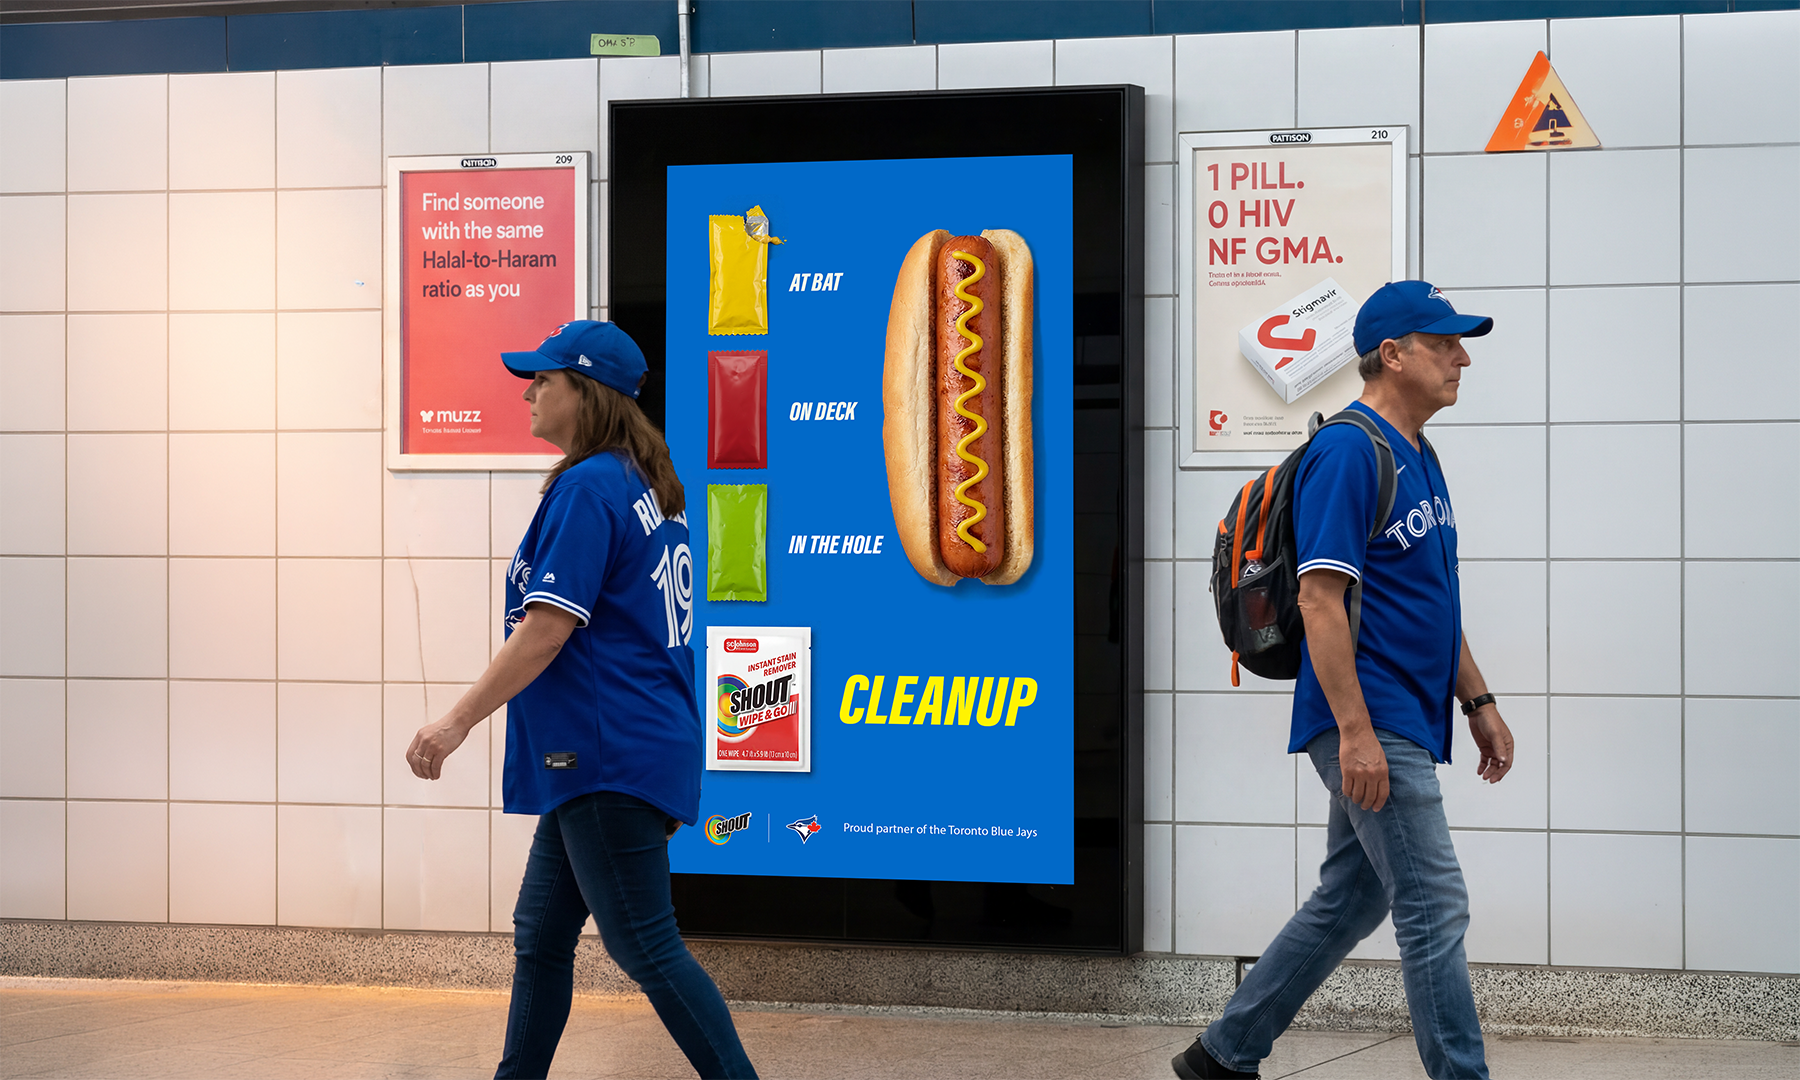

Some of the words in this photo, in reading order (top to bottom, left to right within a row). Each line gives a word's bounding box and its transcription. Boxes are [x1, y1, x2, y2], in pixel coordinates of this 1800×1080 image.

[1272, 133, 1309, 143] PATTISON
[1371, 130, 1388, 139] 210
[555, 155, 573, 164] 209
[1207, 163, 1219, 191] 1
[1230, 161, 1305, 191] PILL.
[422, 192, 460, 211] Find
[463, 195, 545, 211] someone
[1208, 200, 1229, 229] 0
[1239, 198, 1296, 228] HIV
[421, 220, 460, 240] with
[463, 220, 493, 239] the
[496, 224, 544, 239] same
[423, 249, 557, 269] Halal-to-Haram
[1208, 237, 1247, 266] NF
[1255, 235, 1344, 266] GMA.
[422, 279, 462, 298] ratio
[465, 283, 485, 298] as
[488, 283, 520, 303] you
[789, 273, 811, 292] AT
[810, 272, 844, 292] BAT
[1292, 288, 1337, 318] Stigmavir
[437, 410, 482, 423] muzz
[789, 402, 813, 422] ON
[814, 401, 858, 421] DECK
[788, 535, 807, 555] IN
[810, 535, 842, 555] THE
[841, 535, 884, 555] HOLE
[650, 543, 693, 649] 19
[747, 657, 777, 673] INSTANT
[776, 651, 797, 665] STAIN
[763, 660, 797, 677] REMOVER
[730, 673, 793, 714] SHOUT
[839, 673, 1038, 727] CLEANUP
[739, 711, 764, 727] WIPE
[764, 709, 773, 720] &
[773, 705, 788, 718] GO
[716, 812, 751, 835] SHOUT
[843, 822, 874, 833] Proud
[876, 824, 915, 836] partner
[916, 823, 928, 835] of
[929, 824, 947, 835] the
[947, 825, 989, 836] Toronto
[991, 826, 1014, 837] Blue
[1016, 827, 1038, 840] Jays
